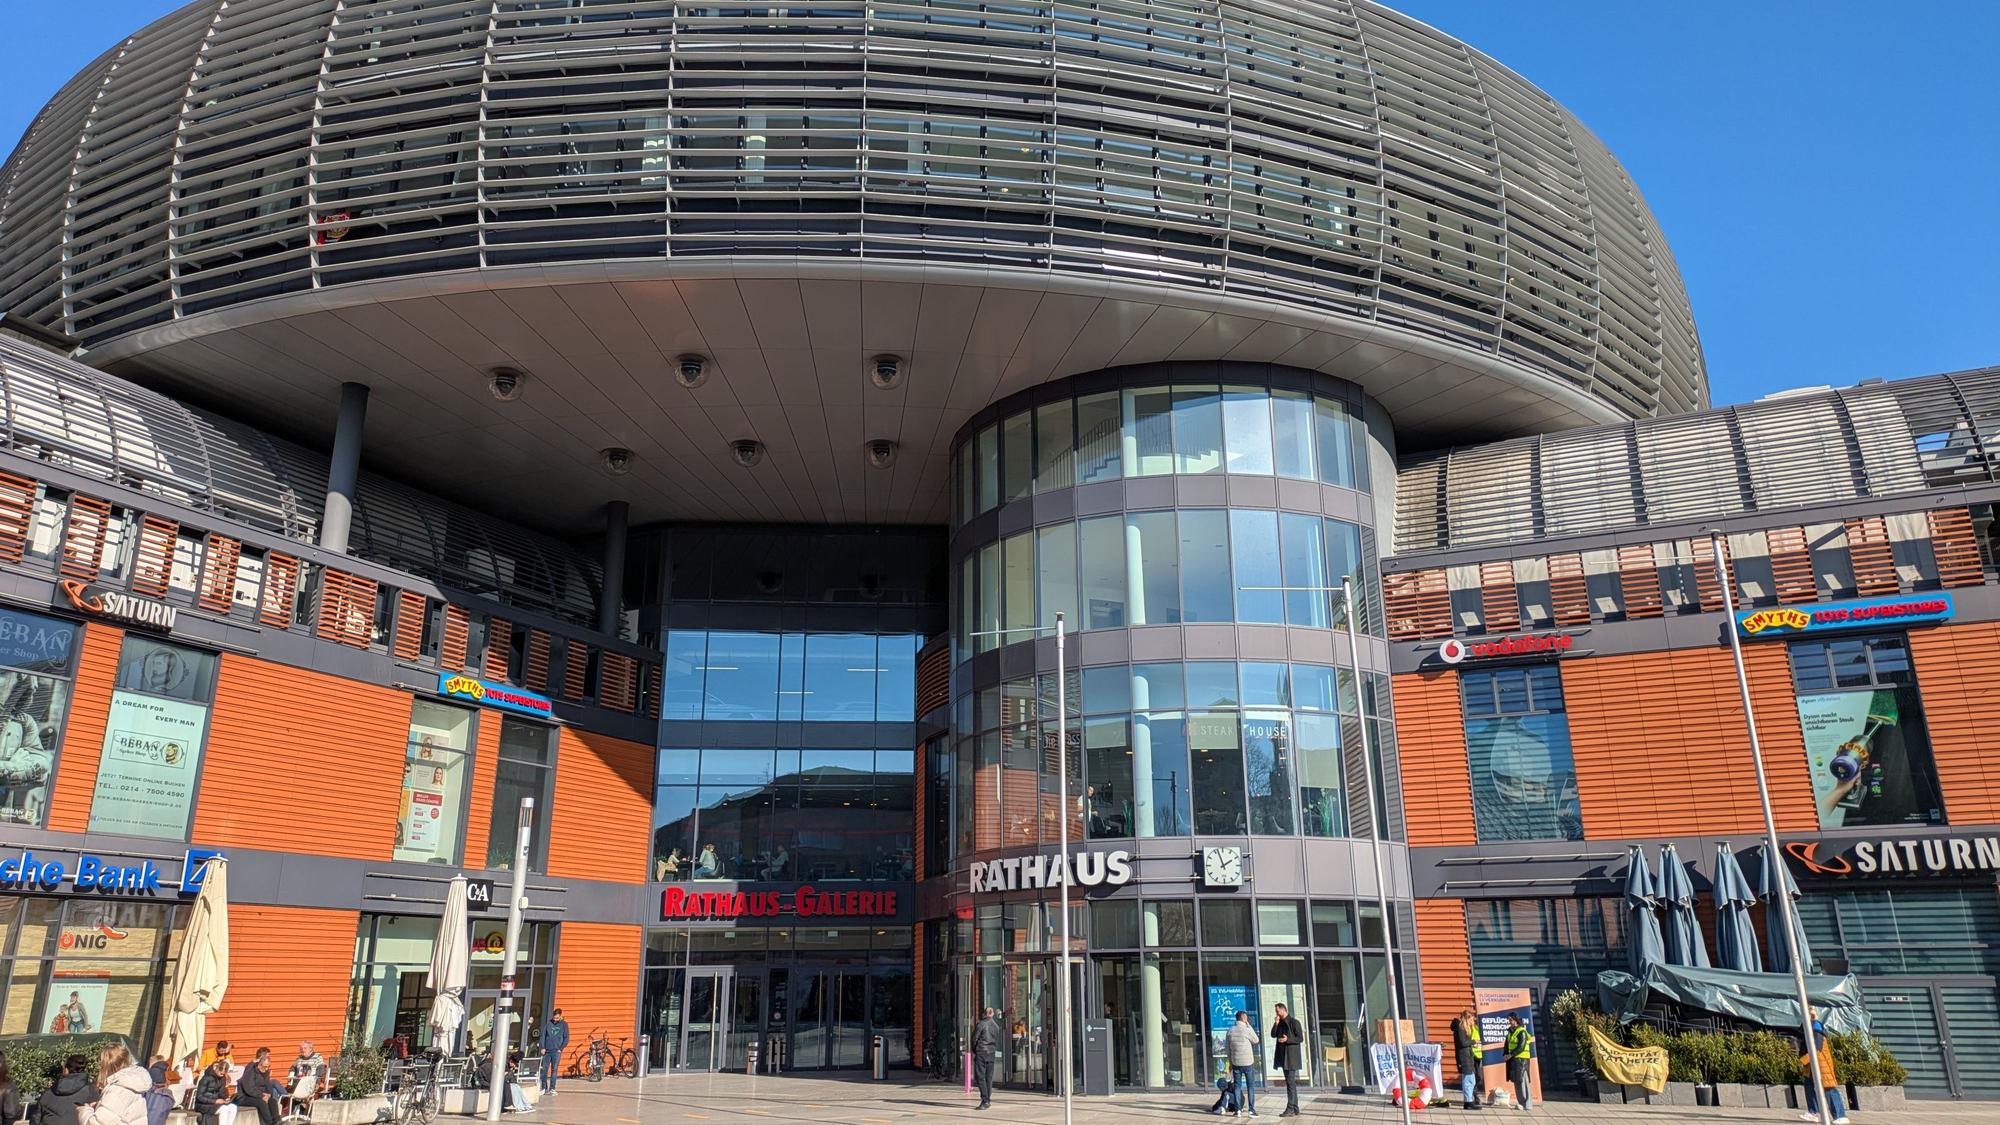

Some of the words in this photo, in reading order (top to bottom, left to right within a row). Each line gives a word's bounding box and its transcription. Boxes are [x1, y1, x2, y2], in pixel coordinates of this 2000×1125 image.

[104, 592, 177, 628] SATURN
[1744, 610, 1809, 631] SMYTHS
[1815, 610, 1849, 622] TOYS
[1853, 601, 1946, 618] SUPERSTORES
[14, 647, 39, 662] Shop
[1471, 634, 1572, 657] vodafone
[447, 677, 485, 697] SMYTHS
[122, 700, 148, 710] DREAM
[149, 705, 165, 713] FOR
[155, 715, 178, 724] EVERY
[179, 719, 196, 727] MAN
[1249, 726, 1286, 738] HOUSE
[146, 788, 165, 796] 7500
[1855, 837, 2000, 873] SATURN
[74, 855, 161, 890] Bank
[970, 850, 1132, 893] RATHAUS
[467, 883, 489, 902] C&A
[1627, 1056, 1660, 1066] HETZE
